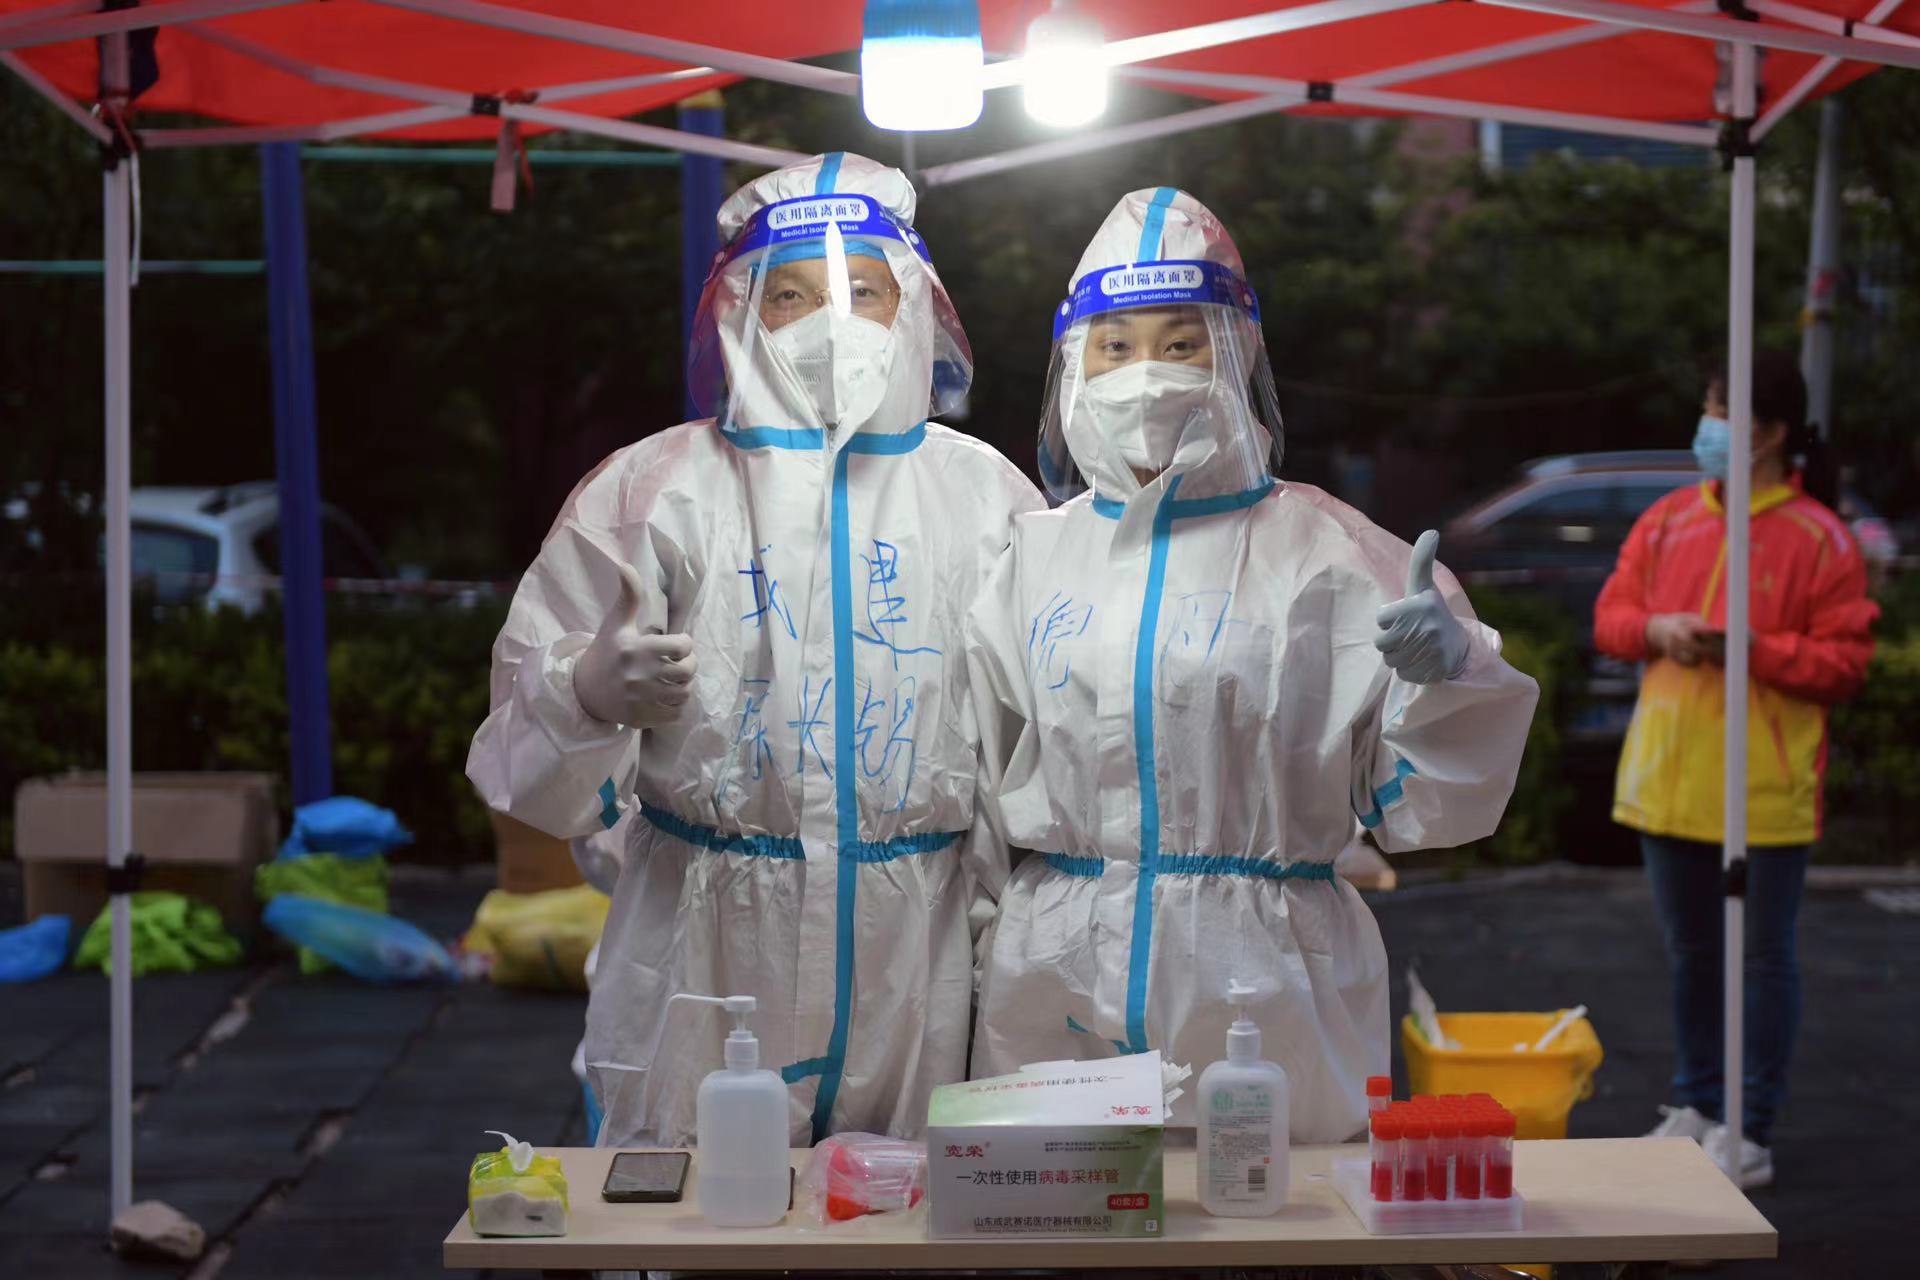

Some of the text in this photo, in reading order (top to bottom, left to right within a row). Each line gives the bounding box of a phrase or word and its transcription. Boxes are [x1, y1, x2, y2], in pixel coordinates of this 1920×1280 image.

[780, 227, 808, 238] Medical
[841, 223, 859, 232] Mask
[1112, 289, 1192, 304] Medical Isolation Mask
[956, 1168, 1120, 1186] 一次性使用病毒采样管
